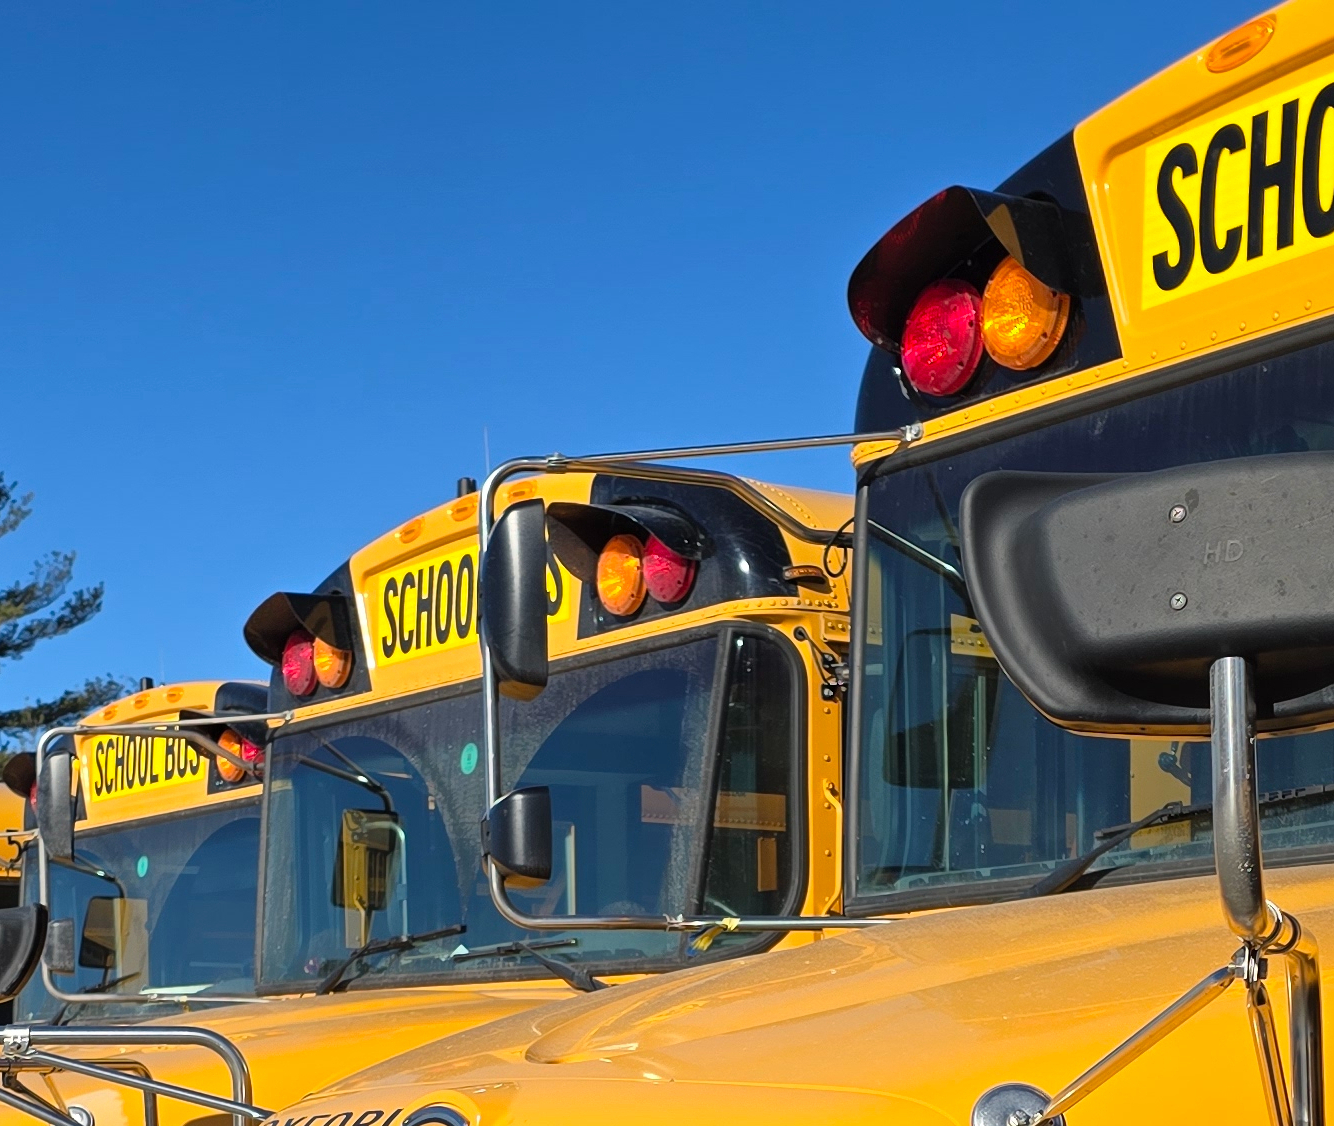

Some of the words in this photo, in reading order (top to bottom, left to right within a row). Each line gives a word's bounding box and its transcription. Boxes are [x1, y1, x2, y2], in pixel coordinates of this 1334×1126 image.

[382, 553, 480, 659] SCHOO
[94, 736, 159, 796] SCHOOL
[164, 737, 201, 776] BUS
